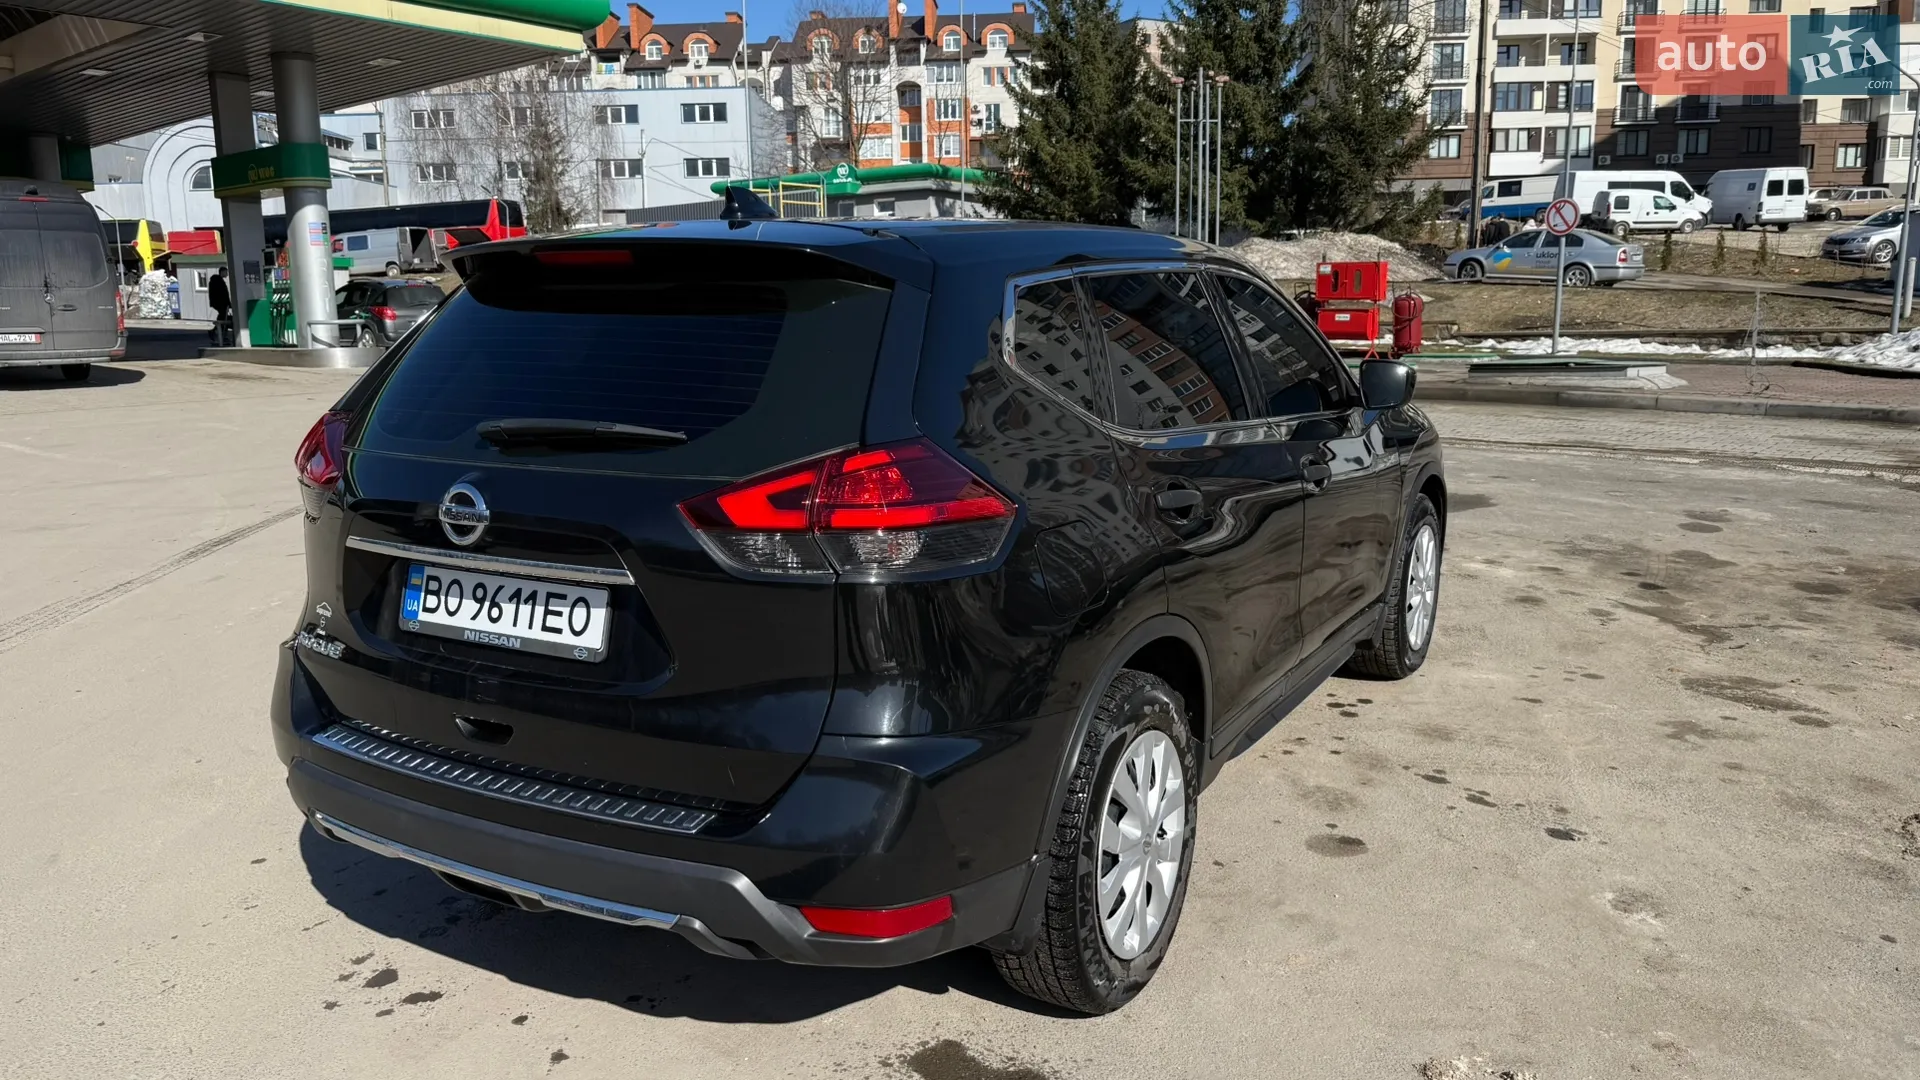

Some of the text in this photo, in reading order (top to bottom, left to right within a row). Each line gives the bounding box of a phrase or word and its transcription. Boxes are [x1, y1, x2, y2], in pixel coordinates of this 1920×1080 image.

[407, 599, 418, 611] UA
[470, 582, 539, 630] 9611
[463, 629, 521, 649] NISSAN
